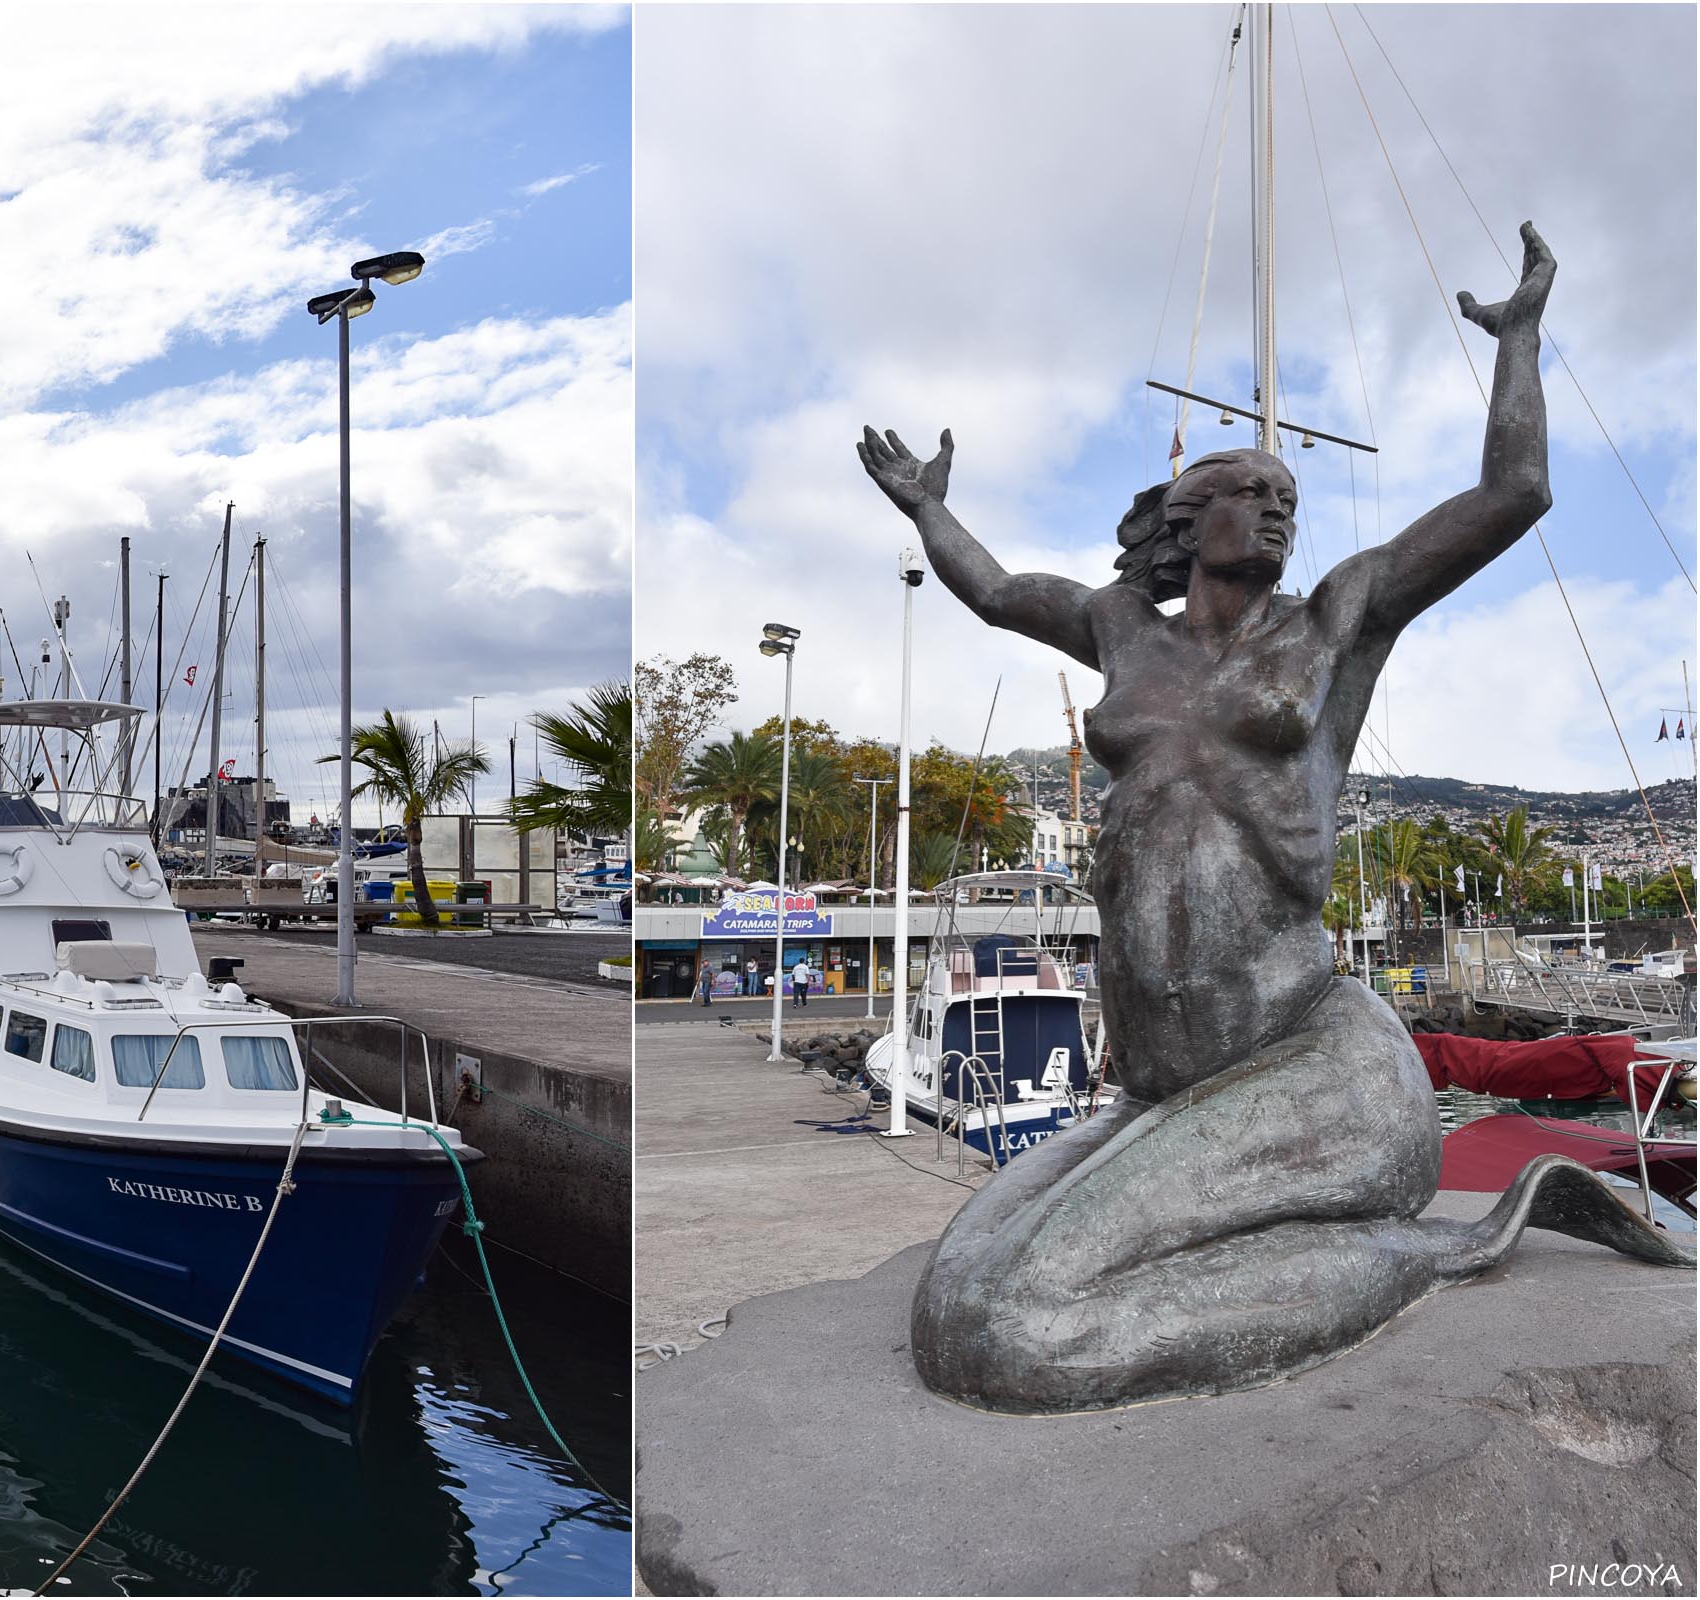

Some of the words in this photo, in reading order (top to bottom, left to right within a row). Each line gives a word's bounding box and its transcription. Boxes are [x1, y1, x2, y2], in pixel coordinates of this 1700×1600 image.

[744, 897, 772, 911] SEA
[787, 919, 814, 929] TRIPS
[998, 1130, 1061, 1151] KAT
[107, 1177, 241, 1210] KATHERINE
[244, 1195, 264, 1212] B
